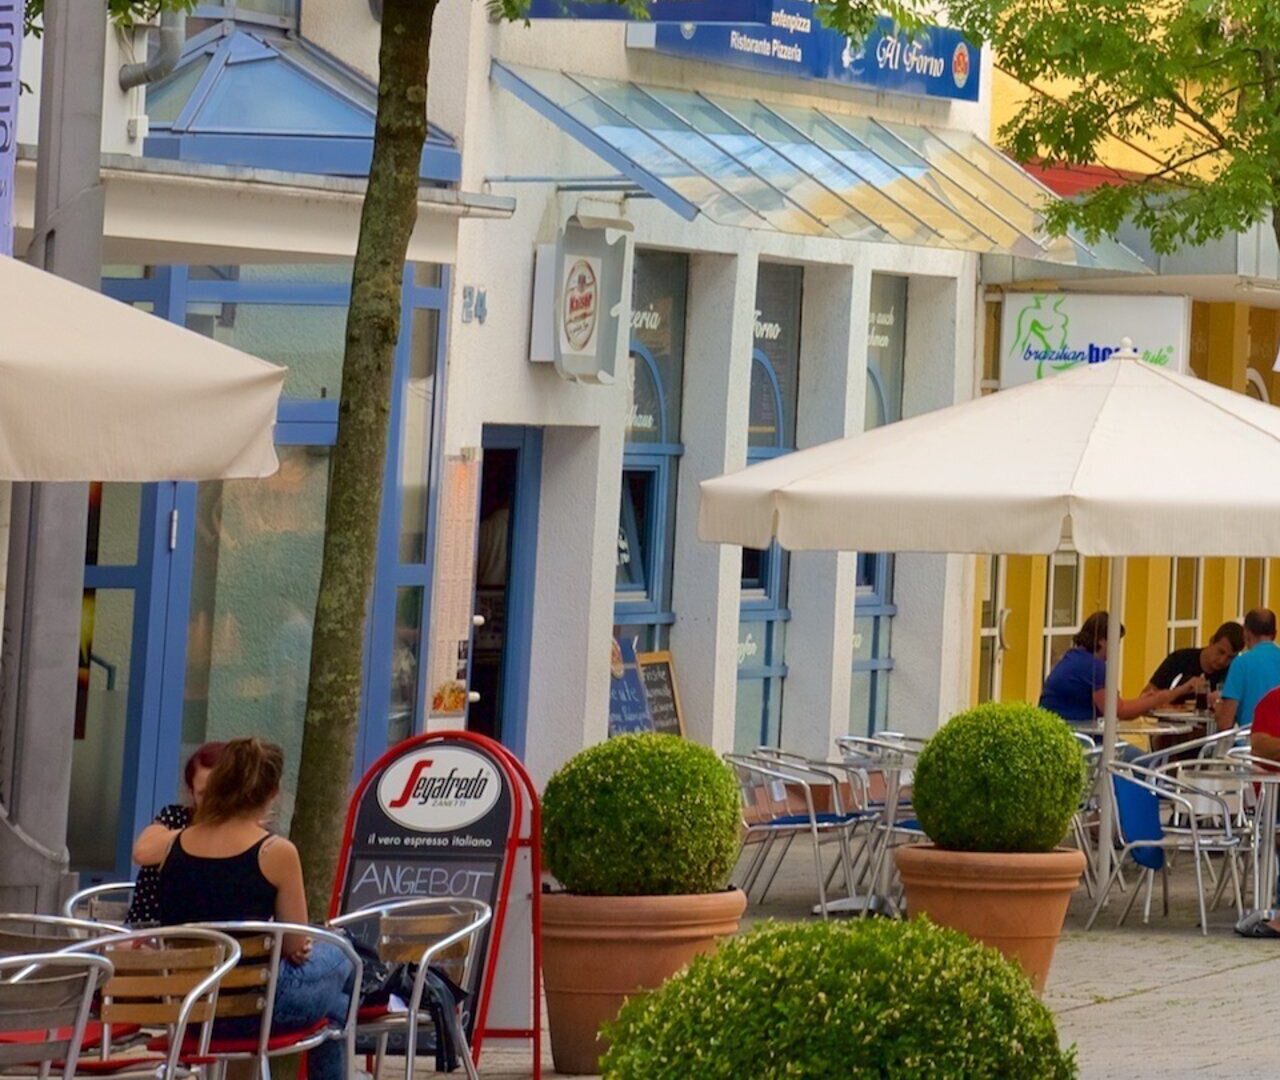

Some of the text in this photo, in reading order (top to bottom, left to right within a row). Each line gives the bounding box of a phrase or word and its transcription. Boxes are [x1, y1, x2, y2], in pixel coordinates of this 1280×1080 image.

[730, 30, 802, 63] Ristorante Pizzeria
[462, 284, 488, 325] 24
[389, 760, 491, 808] Segafredo
[368, 833, 493, 849] il vero espresso italiano
[352, 861, 495, 898] ANGEBOT
